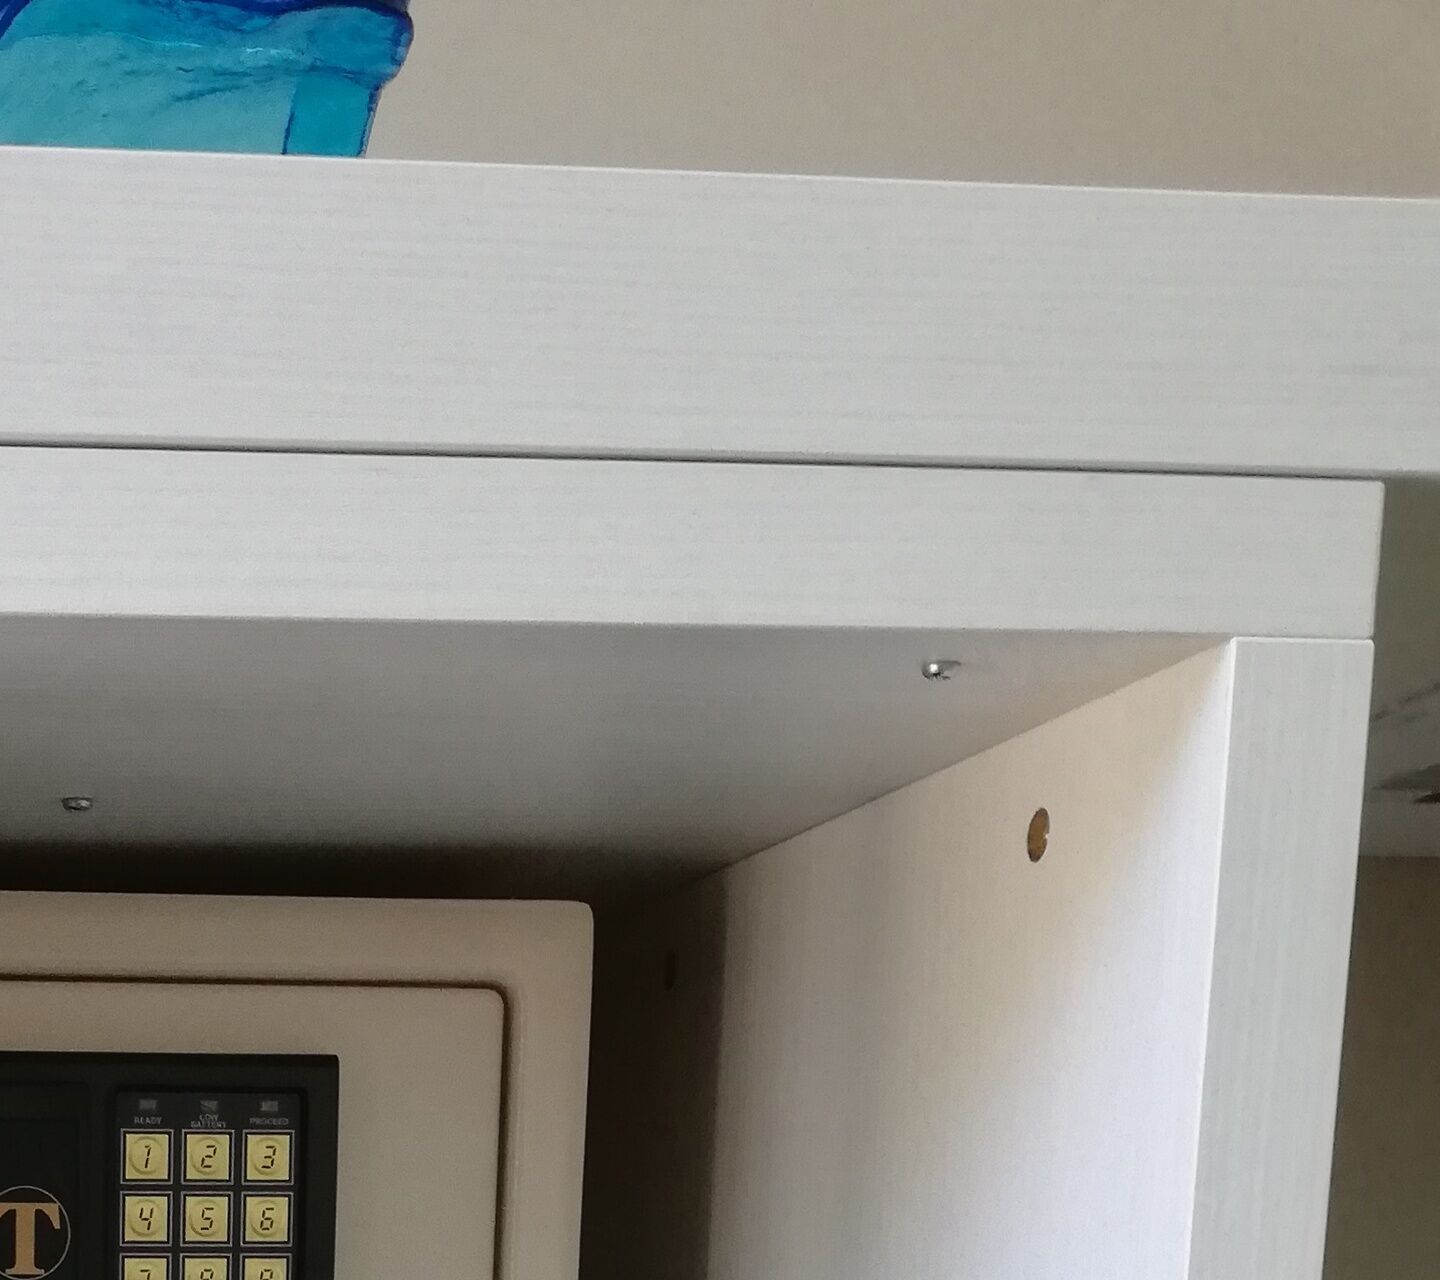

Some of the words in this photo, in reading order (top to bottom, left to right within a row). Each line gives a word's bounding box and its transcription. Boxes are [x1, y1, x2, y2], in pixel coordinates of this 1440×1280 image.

[200, 1145, 217, 1169] 2
[261, 1145, 277, 1169] 3
[139, 1207, 154, 1231] 4
[200, 1207, 215, 1231] 5
[261, 1207, 275, 1231] 6
